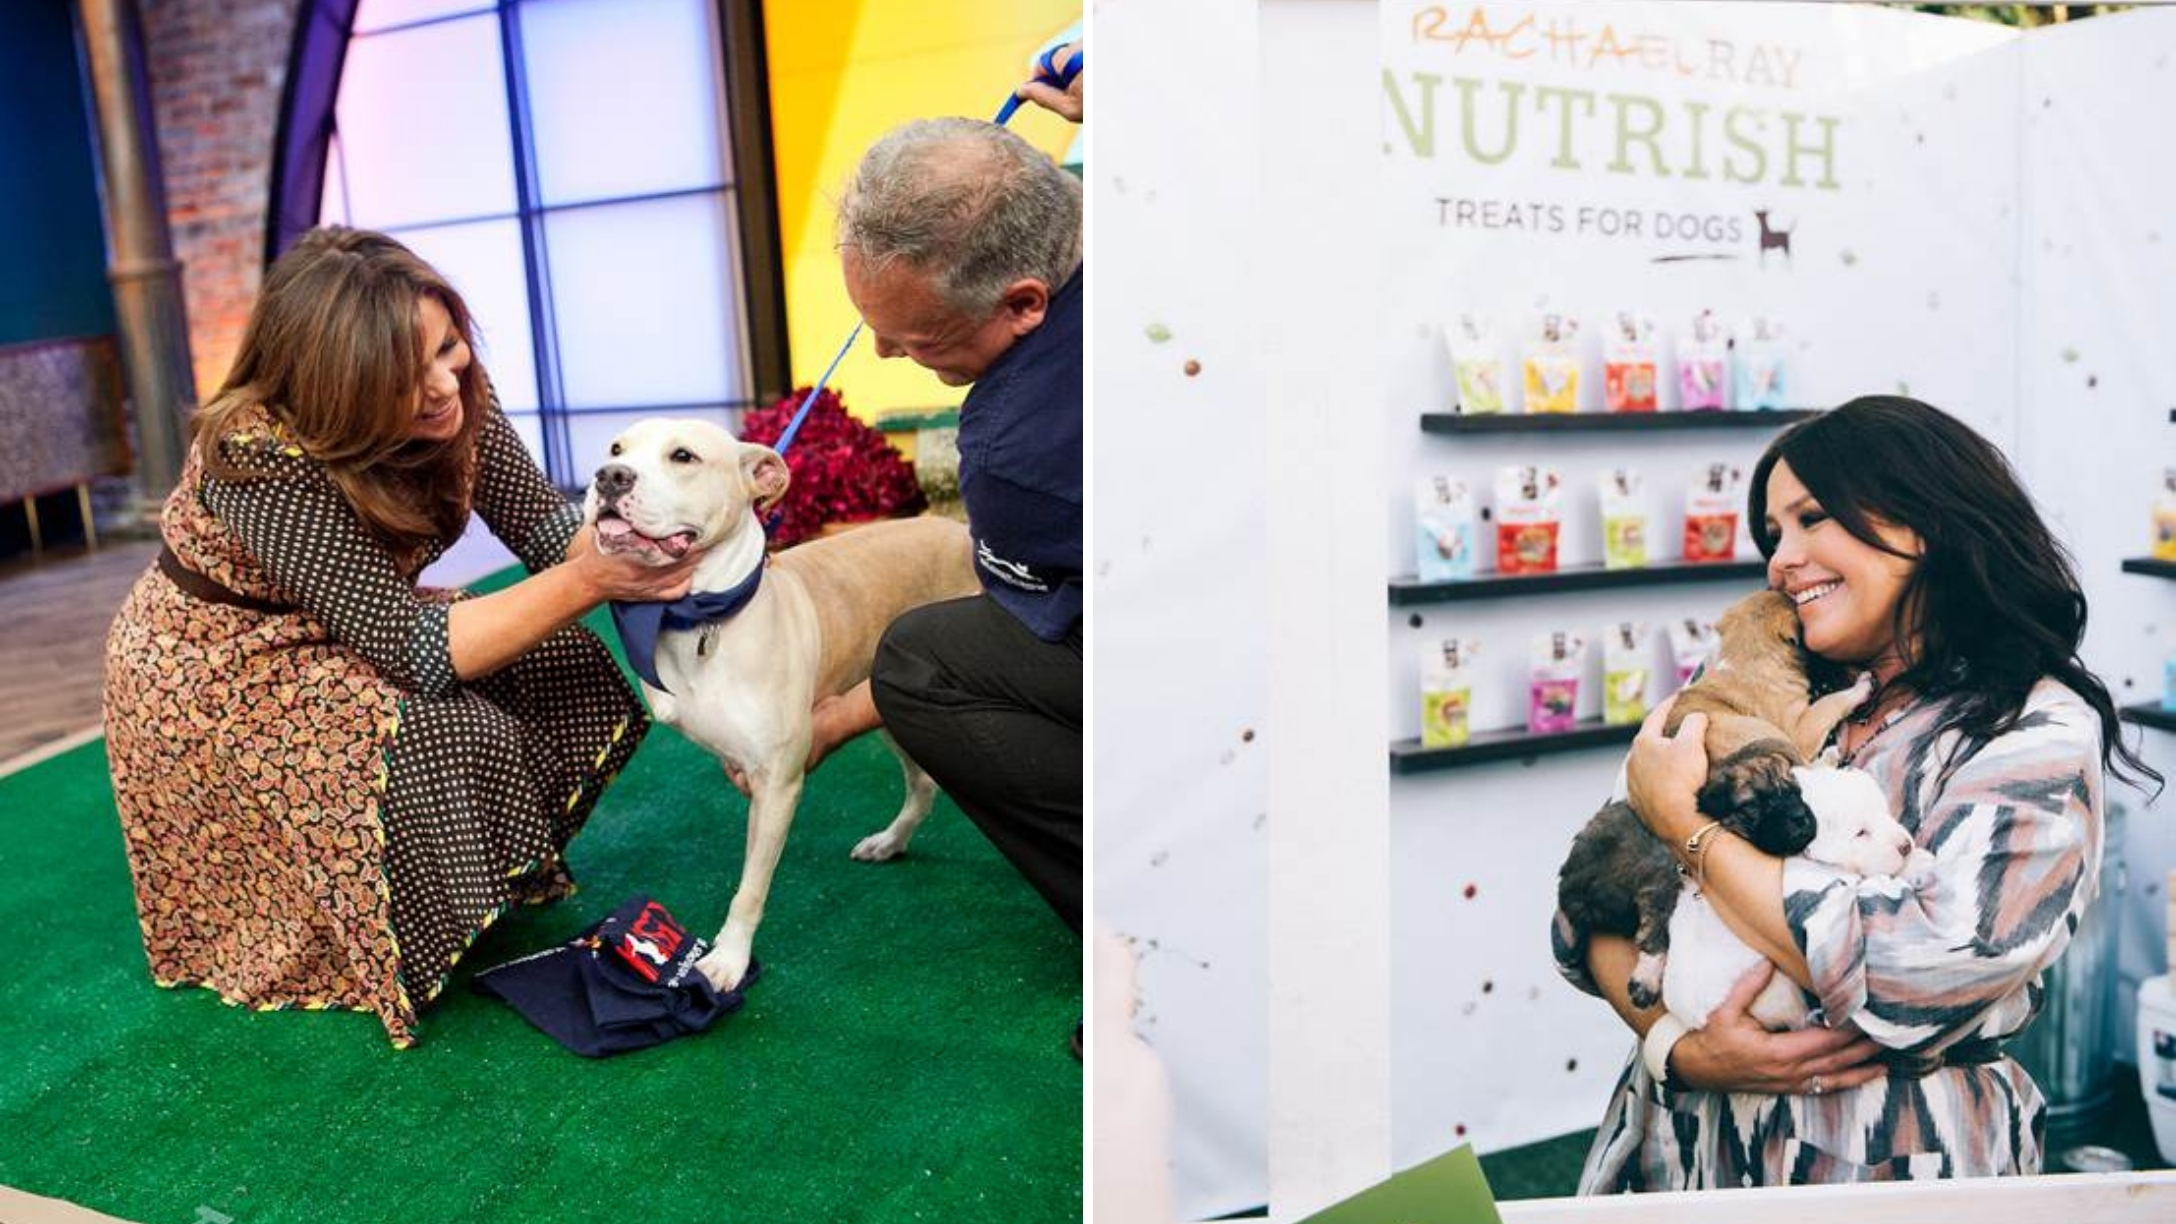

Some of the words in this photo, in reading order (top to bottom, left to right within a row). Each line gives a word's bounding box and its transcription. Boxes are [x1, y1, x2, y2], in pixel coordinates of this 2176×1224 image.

[1411, 6, 1693, 75] RACHAEL
[1707, 38, 1802, 89] RAY
[1381, 68, 1841, 191] NUTRISH
[1435, 197, 1565, 234] TREATS
[1577, 206, 1643, 239] FOR
[1654, 211, 1743, 245] DOGS
